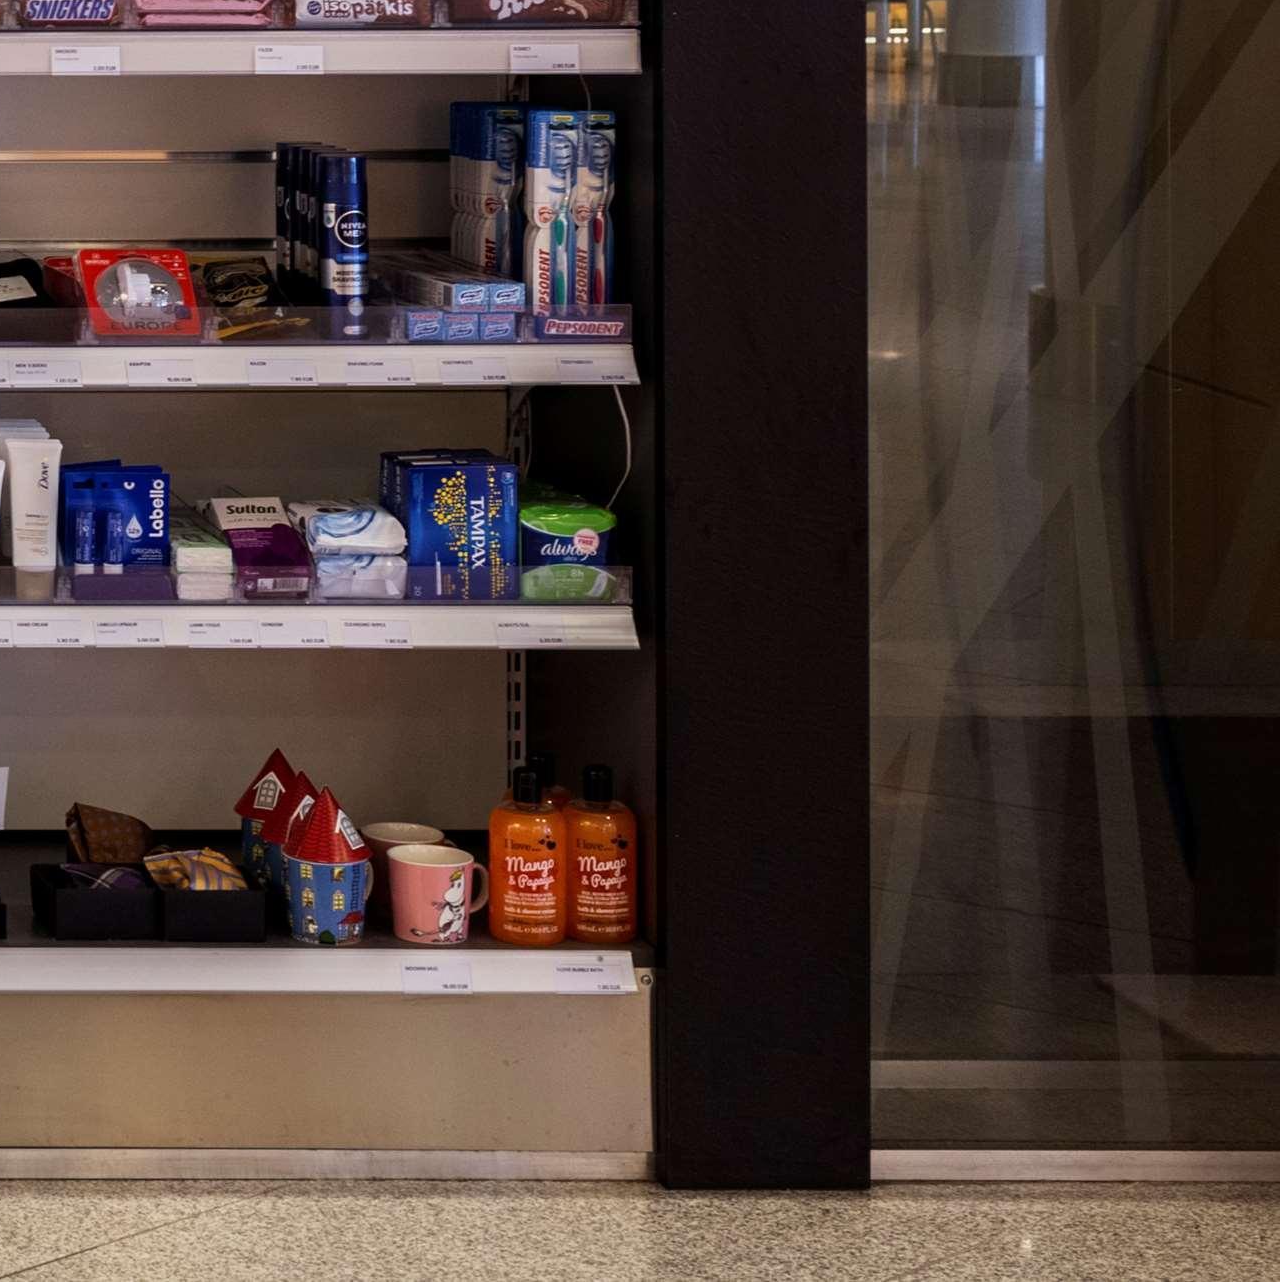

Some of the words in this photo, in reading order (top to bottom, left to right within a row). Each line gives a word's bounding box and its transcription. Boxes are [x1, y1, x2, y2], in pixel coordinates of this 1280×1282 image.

[340, 221, 367, 230] NIVEA
[544, 320, 625, 335] PEPSODENT
[148, 478, 165, 538] Labello
[469, 496, 487, 570] TAMPAX
[505, 856, 555, 877] Mango
[577, 856, 627, 877] Mango
[508, 875, 517, 886] &
[518, 874, 555, 890] Papaya
[581, 875, 589, 886] &
[591, 874, 627, 890] Papaya
